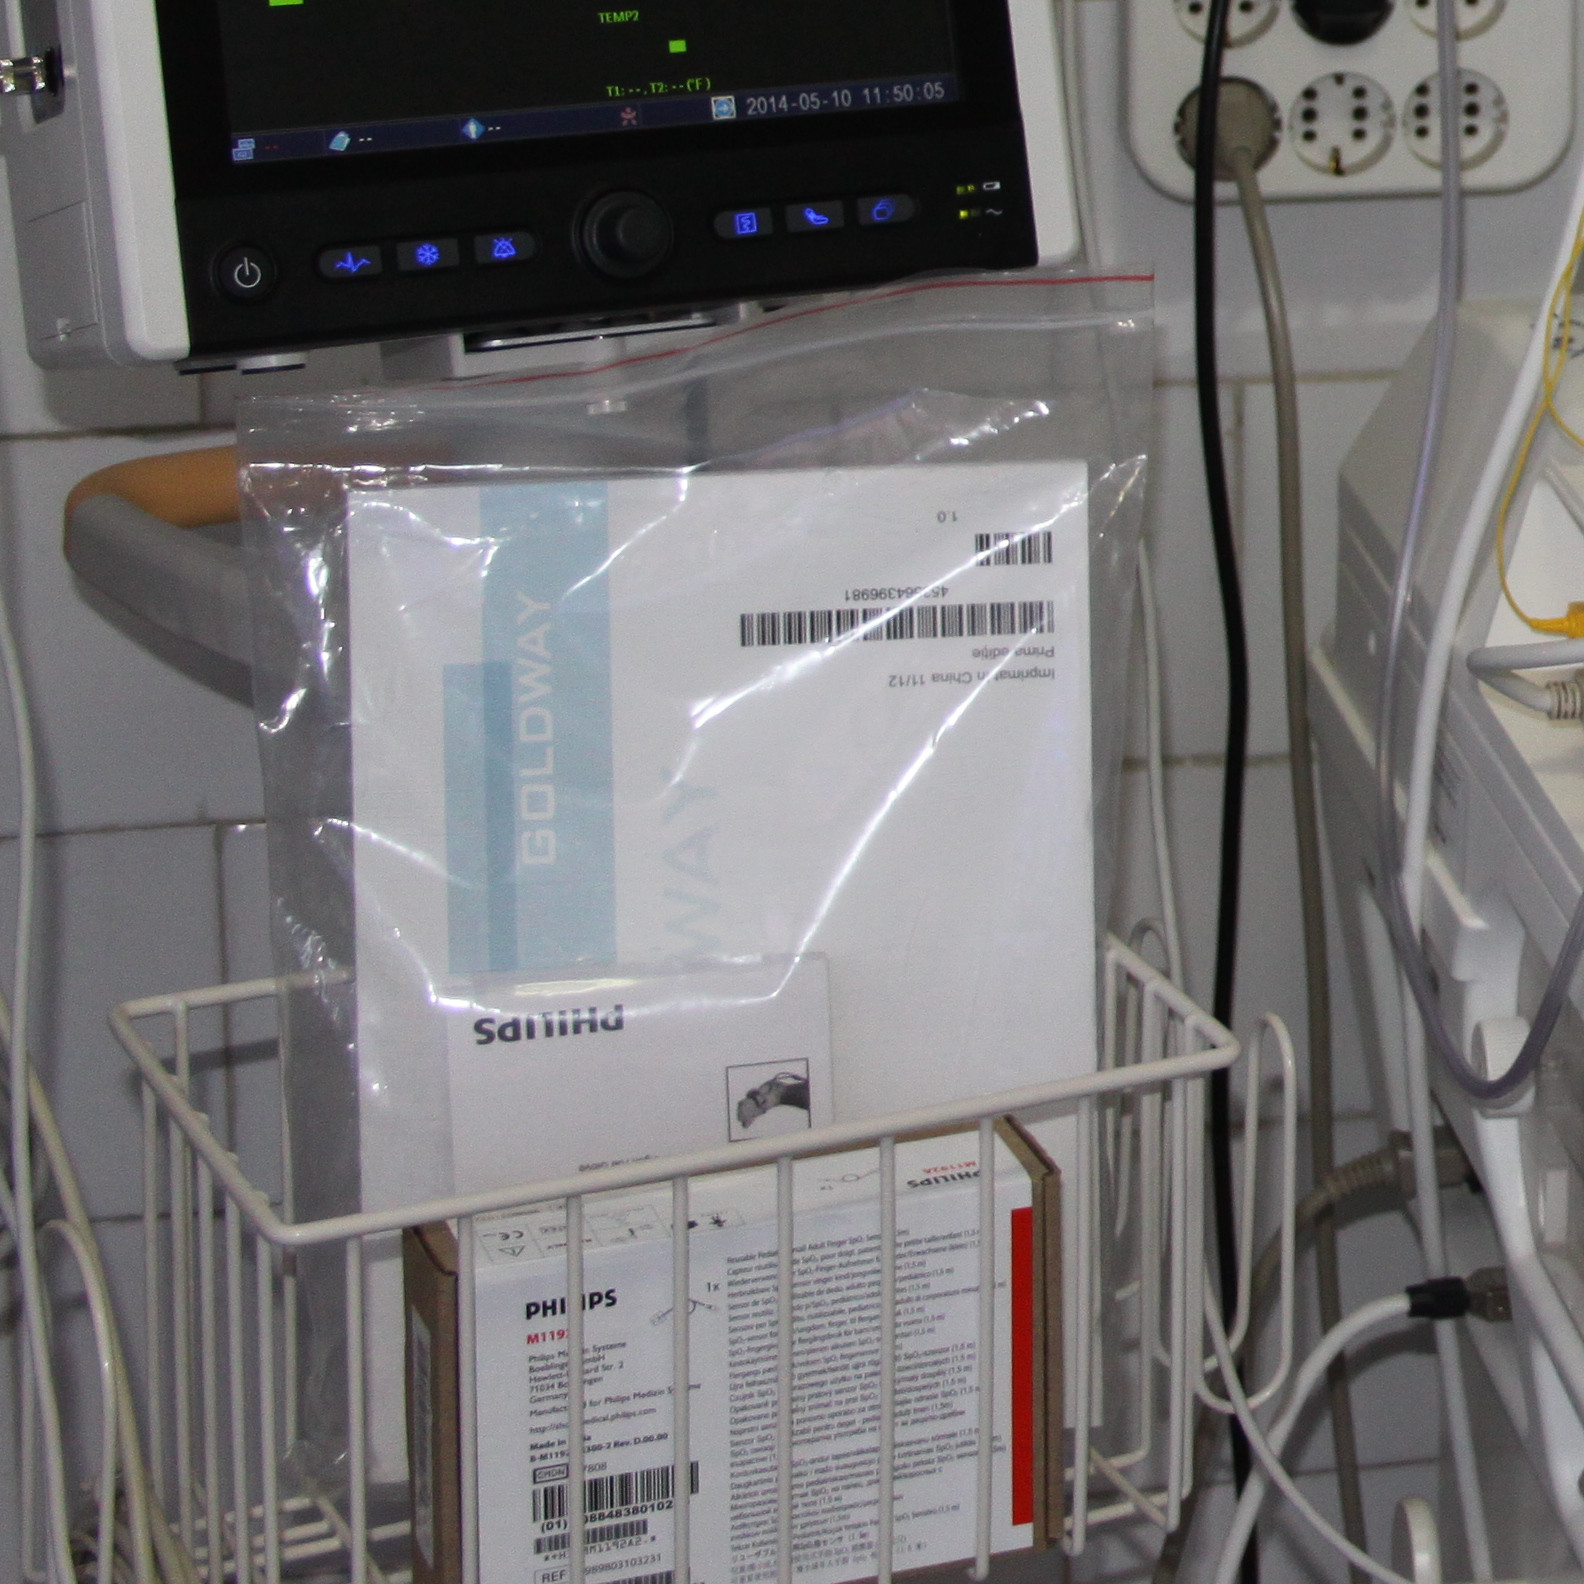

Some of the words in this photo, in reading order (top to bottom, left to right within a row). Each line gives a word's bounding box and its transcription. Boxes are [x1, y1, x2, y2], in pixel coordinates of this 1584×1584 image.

[598, 10, 639, 24] TEMP2
[747, 89, 852, 116] 2014-05-10
[863, 81, 946, 105] 11:50:05
[844, 585, 949, 602] 4564396981
[888, 674, 925, 688] 11/12
[931, 672, 971, 684] China
[516, 590, 558, 865] GOLDWAY
[473, 1004, 624, 1045] PHILIPS
[525, 1288, 618, 1320] PHIIPS
[526, 1328, 569, 1345] M119
[530, 1440, 554, 1450] Made
[542, 1569, 567, 1584] REF
